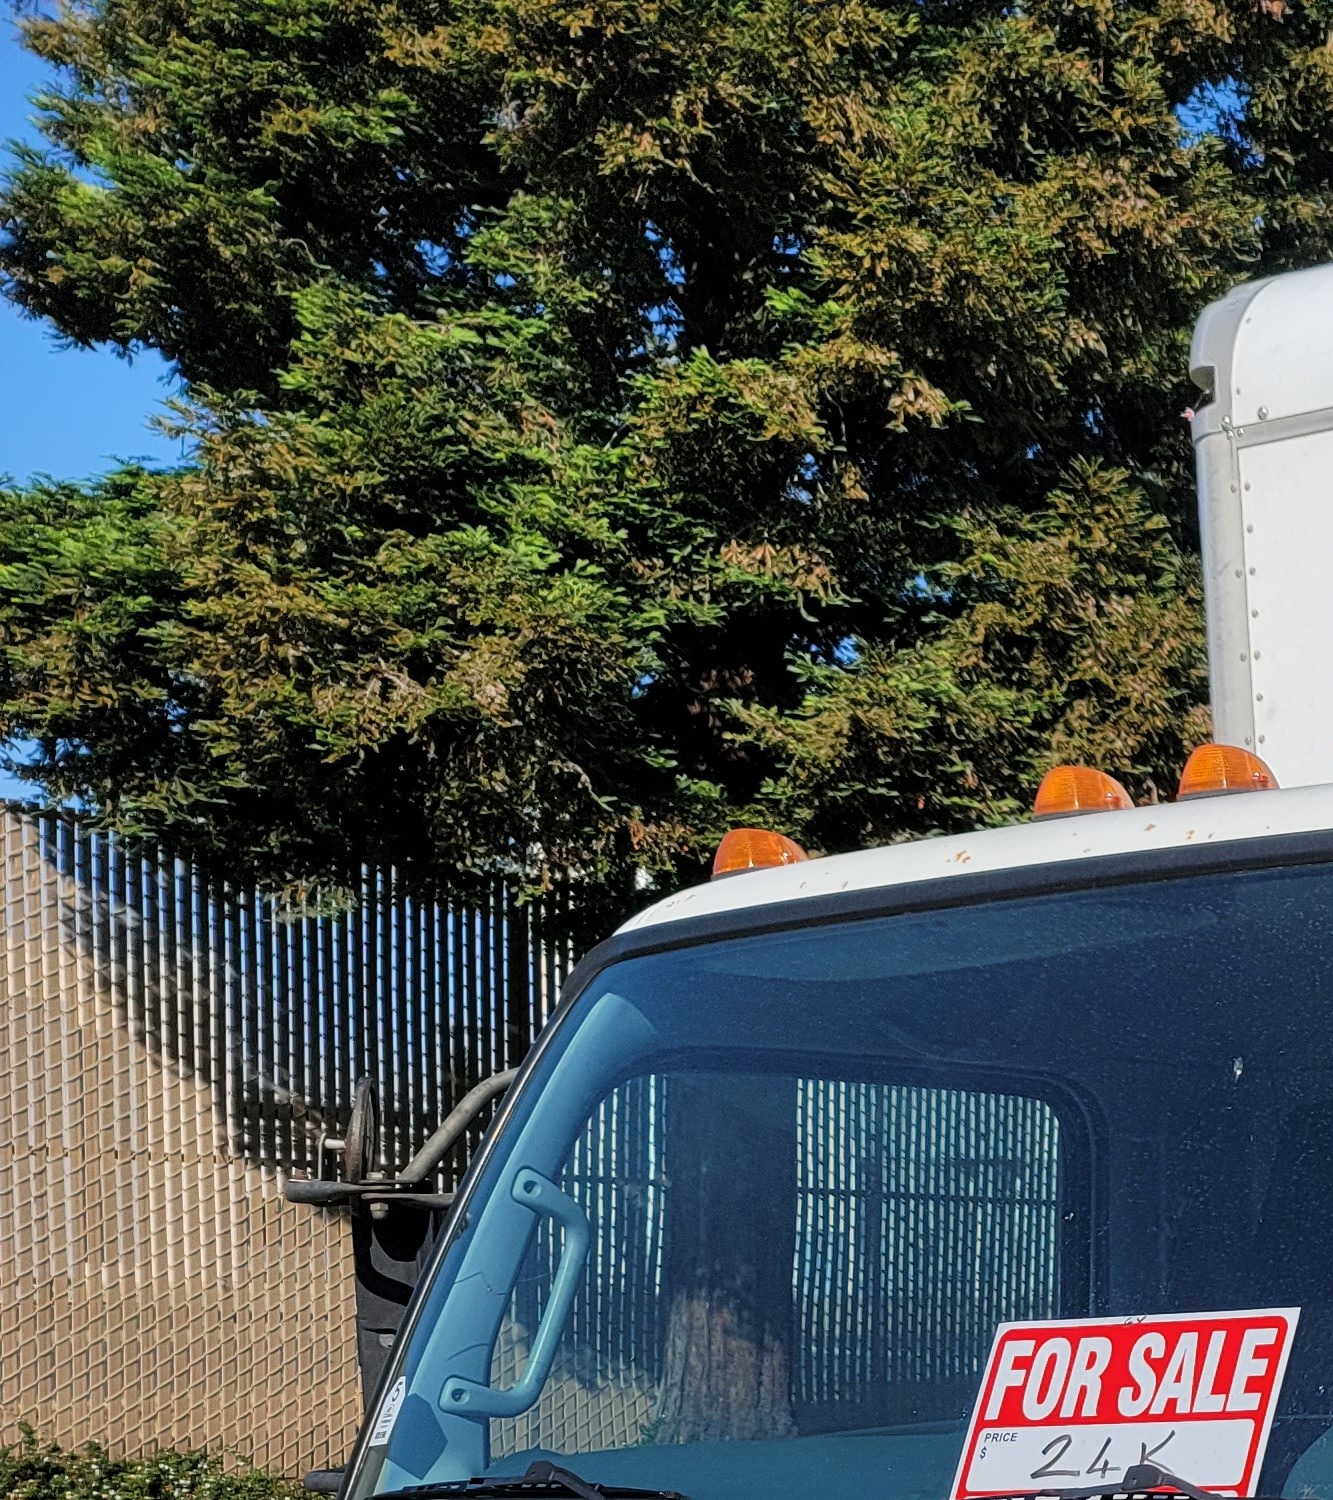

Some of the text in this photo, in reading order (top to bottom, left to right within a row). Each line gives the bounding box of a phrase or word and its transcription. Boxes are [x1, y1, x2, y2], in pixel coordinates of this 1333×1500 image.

[984, 1328, 1278, 1421] FOR SALE
[984, 1432, 1018, 1443] PRICE
[980, 1446, 988, 1460] $
